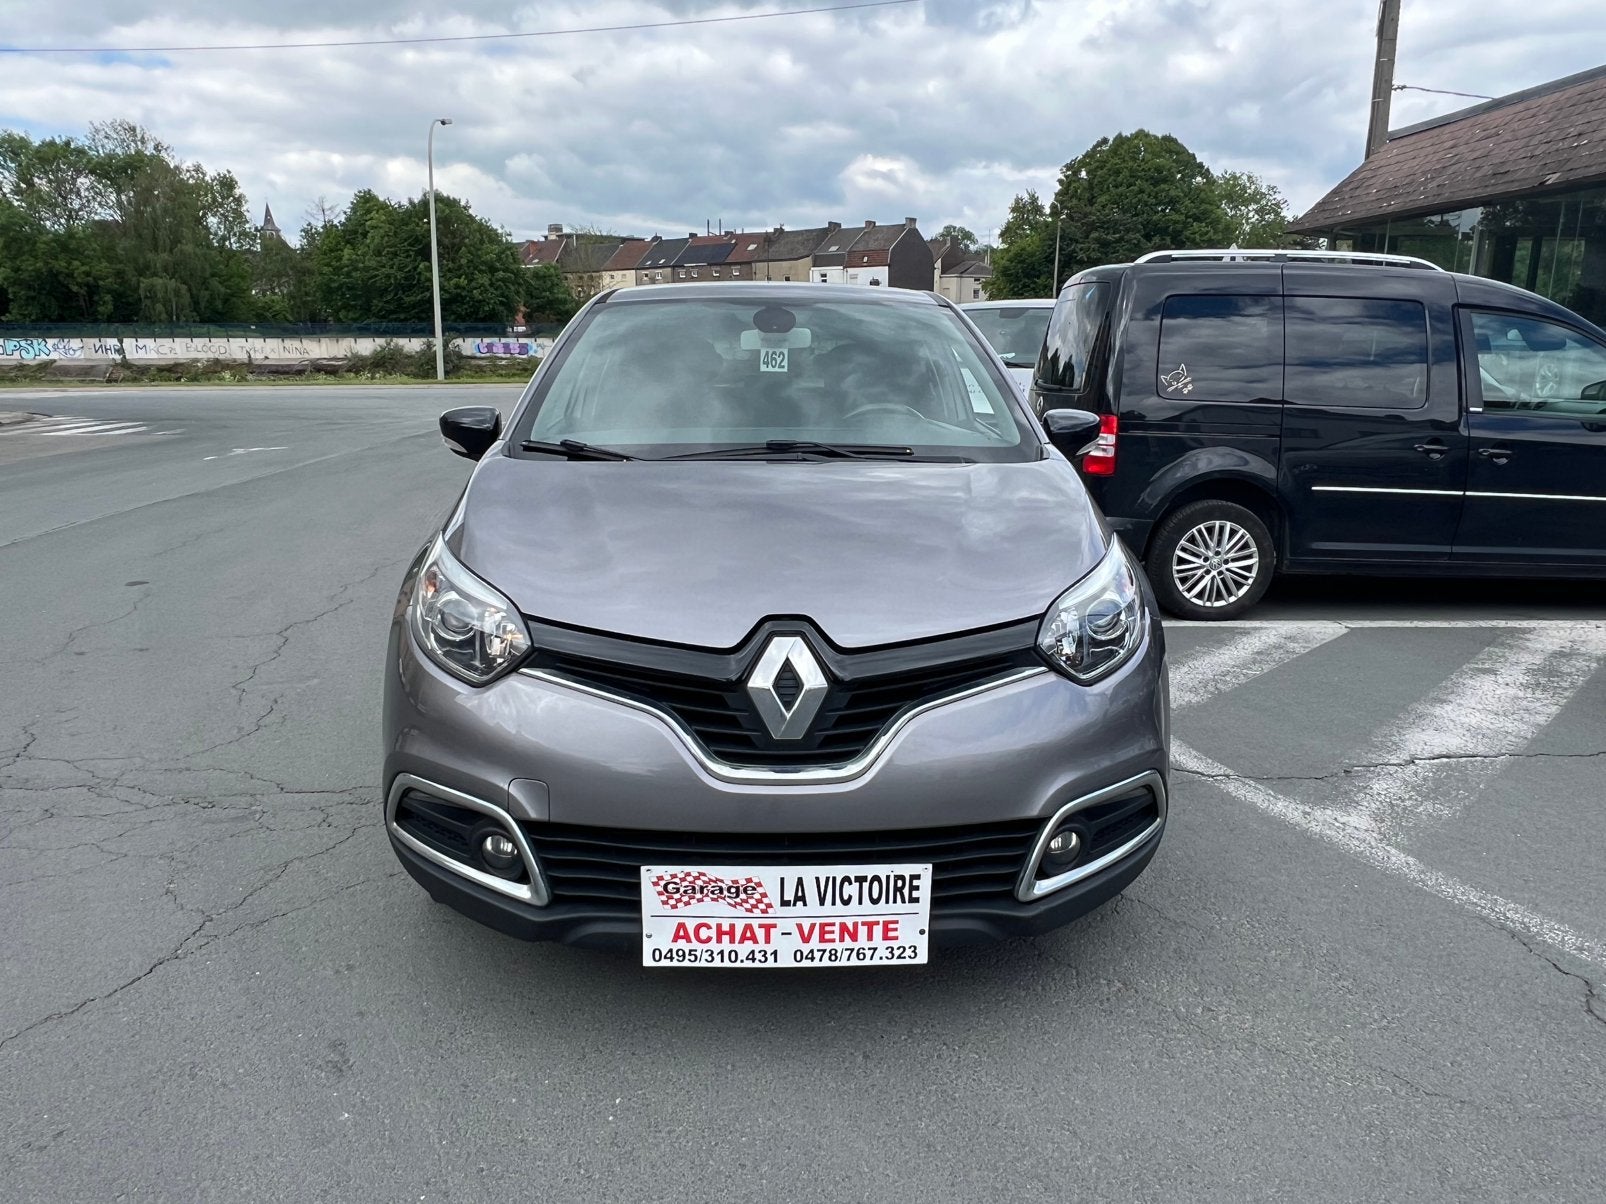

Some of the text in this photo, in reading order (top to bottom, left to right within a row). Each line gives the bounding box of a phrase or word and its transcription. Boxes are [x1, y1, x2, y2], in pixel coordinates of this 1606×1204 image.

[762, 350, 786, 369] 462
[662, 880, 758, 900] Garage
[779, 873, 922, 907] LA VICTOIRE
[651, 944, 918, 964] 0495/310.431 0478/767.323
